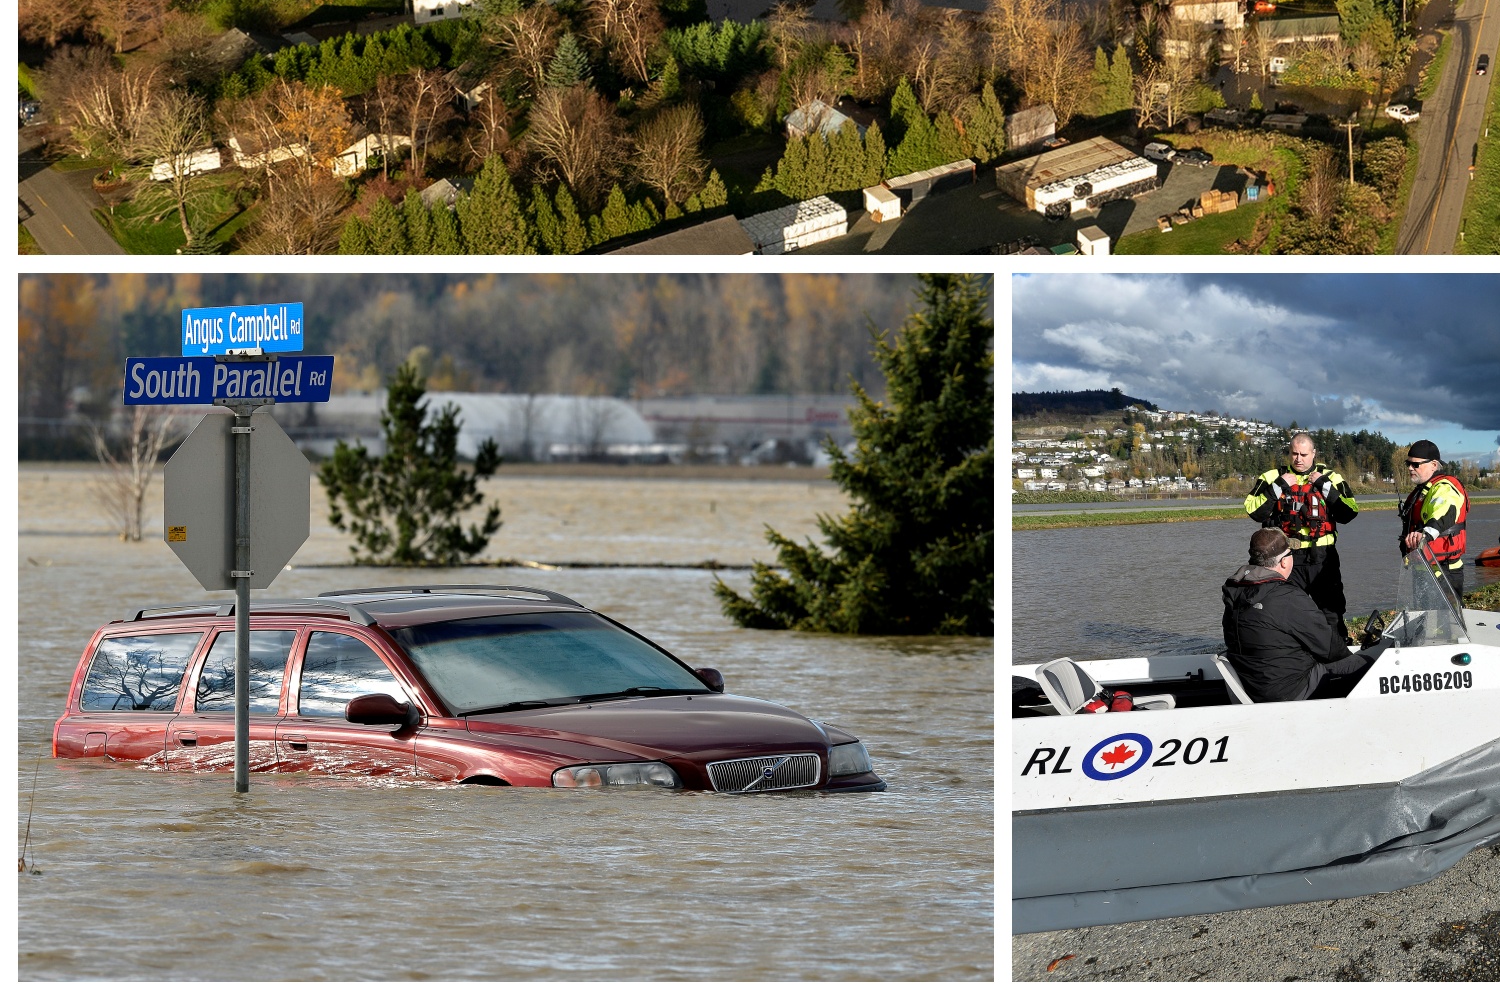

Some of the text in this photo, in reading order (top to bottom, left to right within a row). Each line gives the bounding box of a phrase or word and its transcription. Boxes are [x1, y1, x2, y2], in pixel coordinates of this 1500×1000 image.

[184, 306, 301, 354] Angus Campbell Rd
[129, 360, 327, 399] South Parallel Rd
[1379, 670, 1473, 695] BC4686209
[1020, 735, 1230, 777] RL 201
